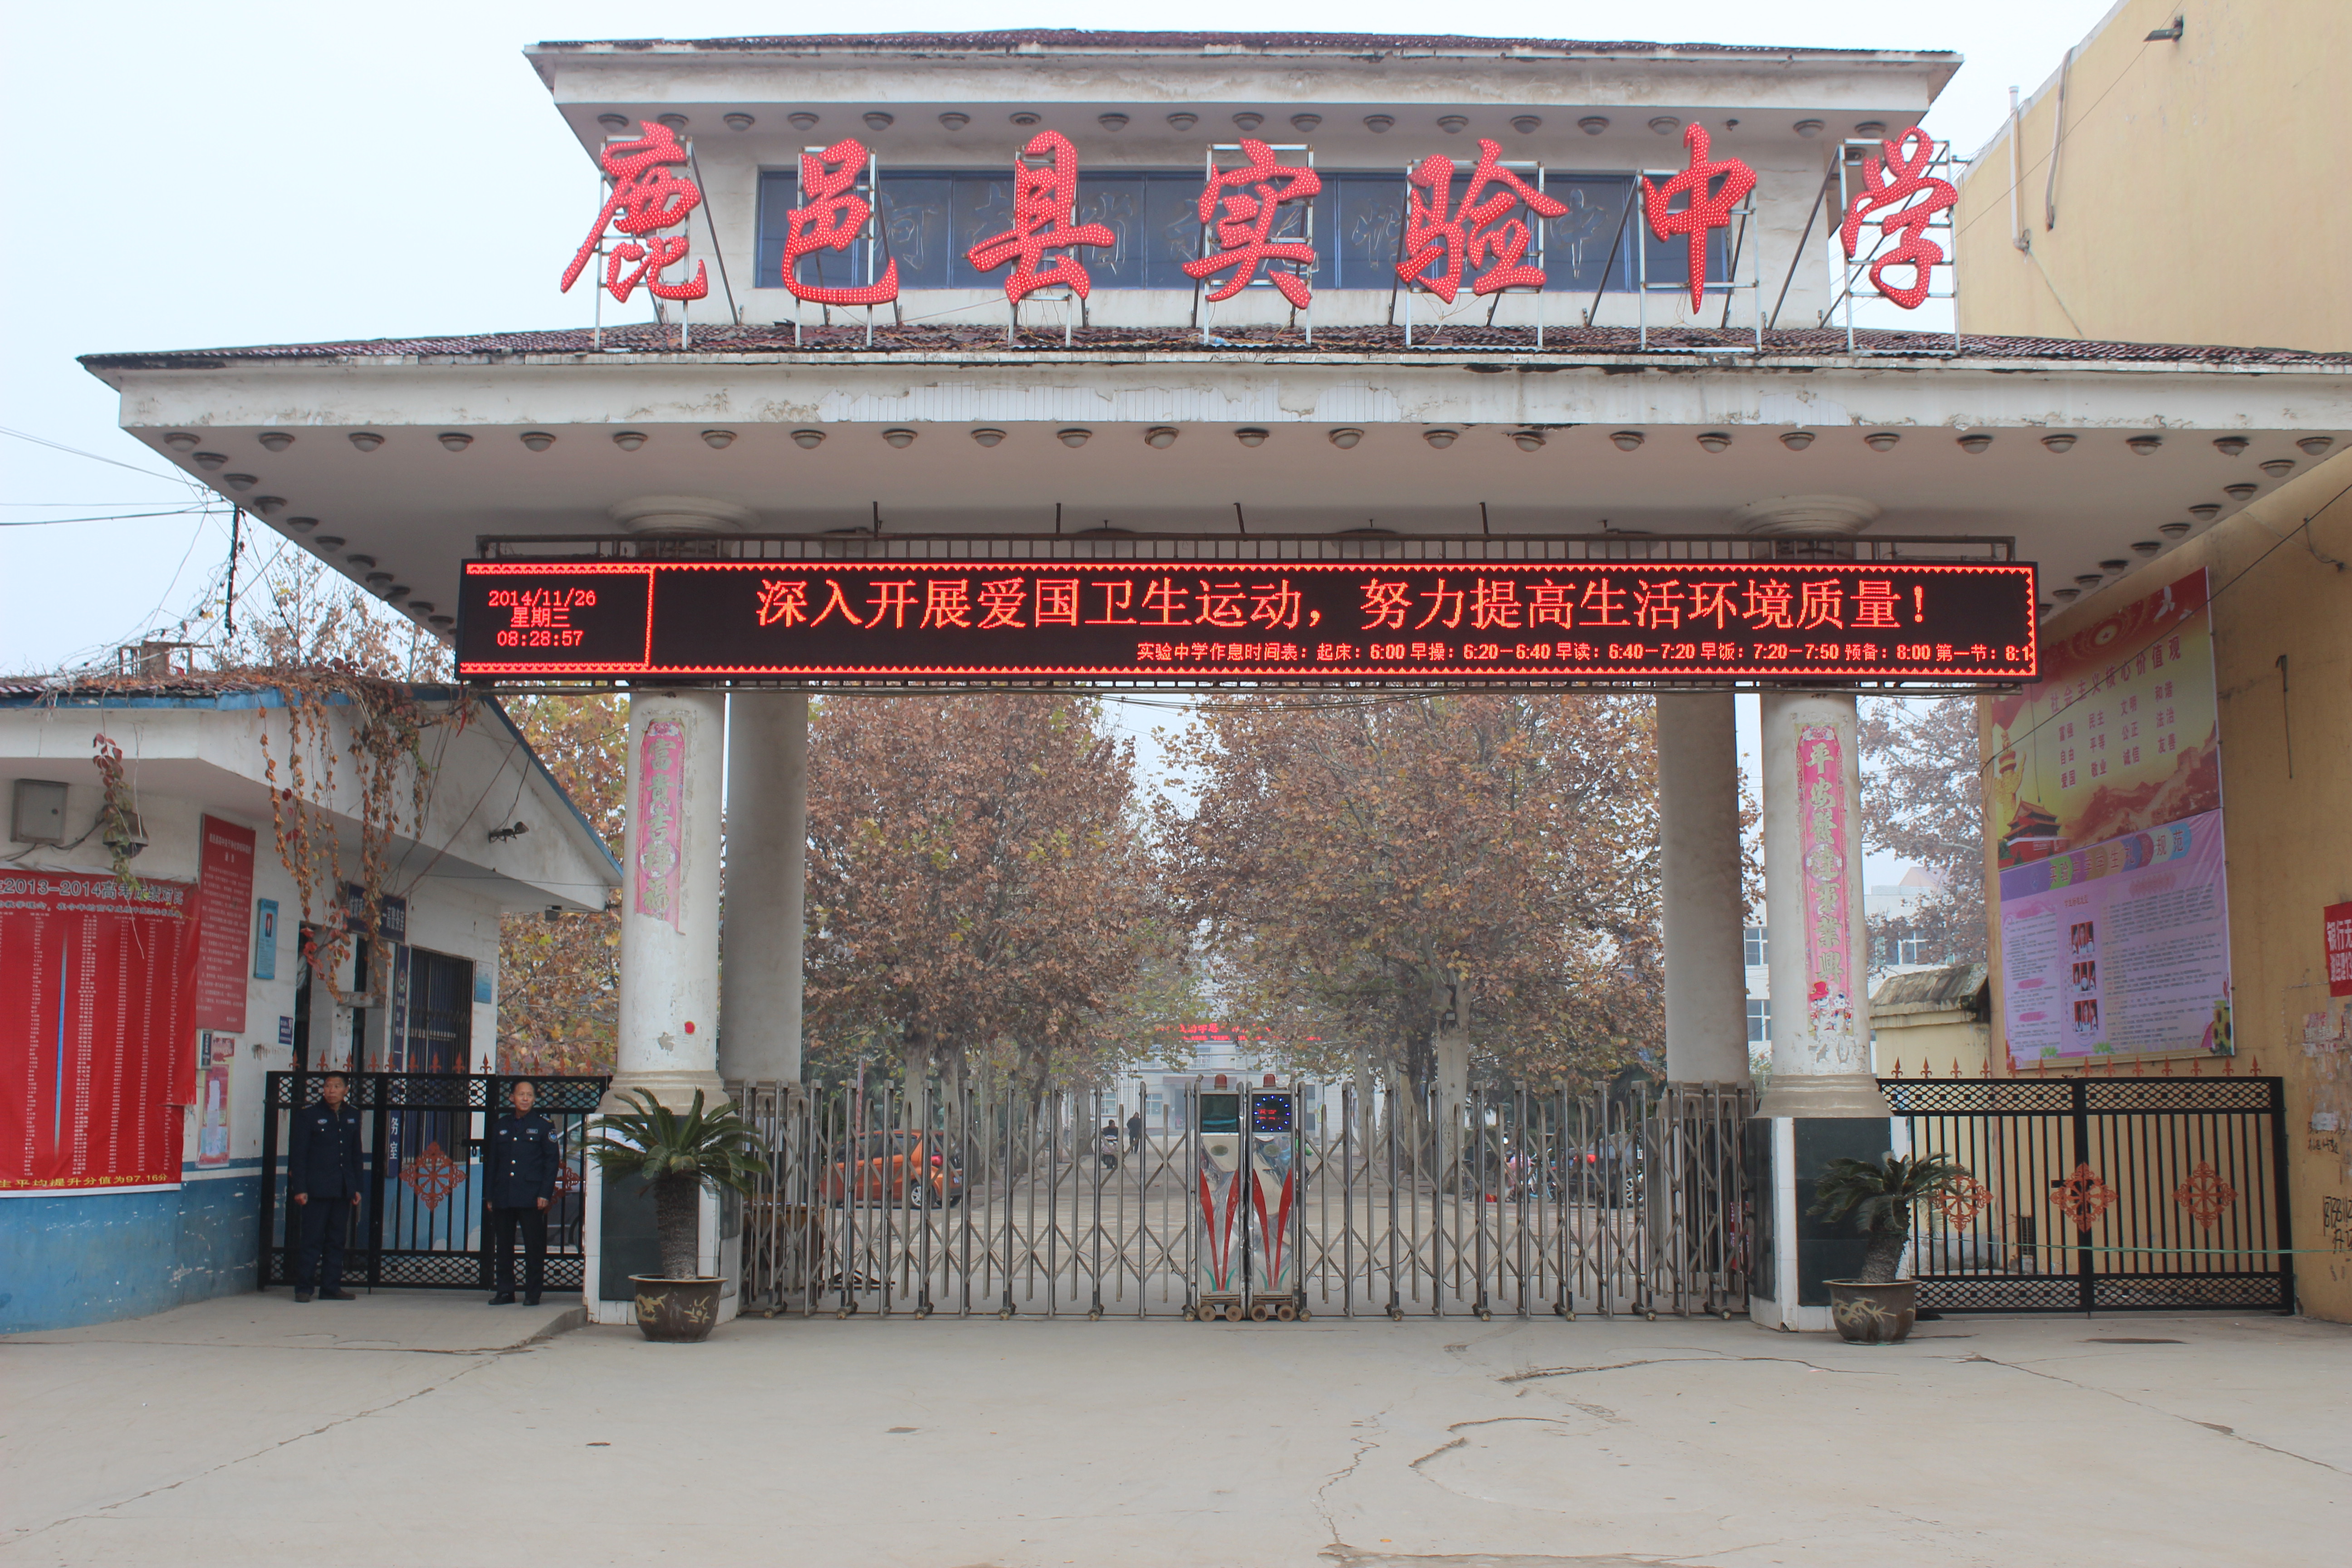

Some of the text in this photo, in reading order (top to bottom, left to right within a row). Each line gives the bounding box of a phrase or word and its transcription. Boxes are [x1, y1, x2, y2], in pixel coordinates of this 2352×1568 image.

[560, 121, 1958, 314] 鹿邑县实验中学
[489, 588, 596, 607] 2014/11/26
[510, 607, 571, 628] 星期三
[497, 631, 583, 647] 08:28:57
[2050, 635, 2181, 715] 社会主义核心价值观
[2059, 681, 2173, 742] 富强 民主 文明 和谐
[2060, 707, 2175, 766] 自由 平等 公正 法治
[2061, 733, 2176, 789] 爱国 敬业 诚信 友善
[642, 738, 676, 919] 富貴吉祥福
